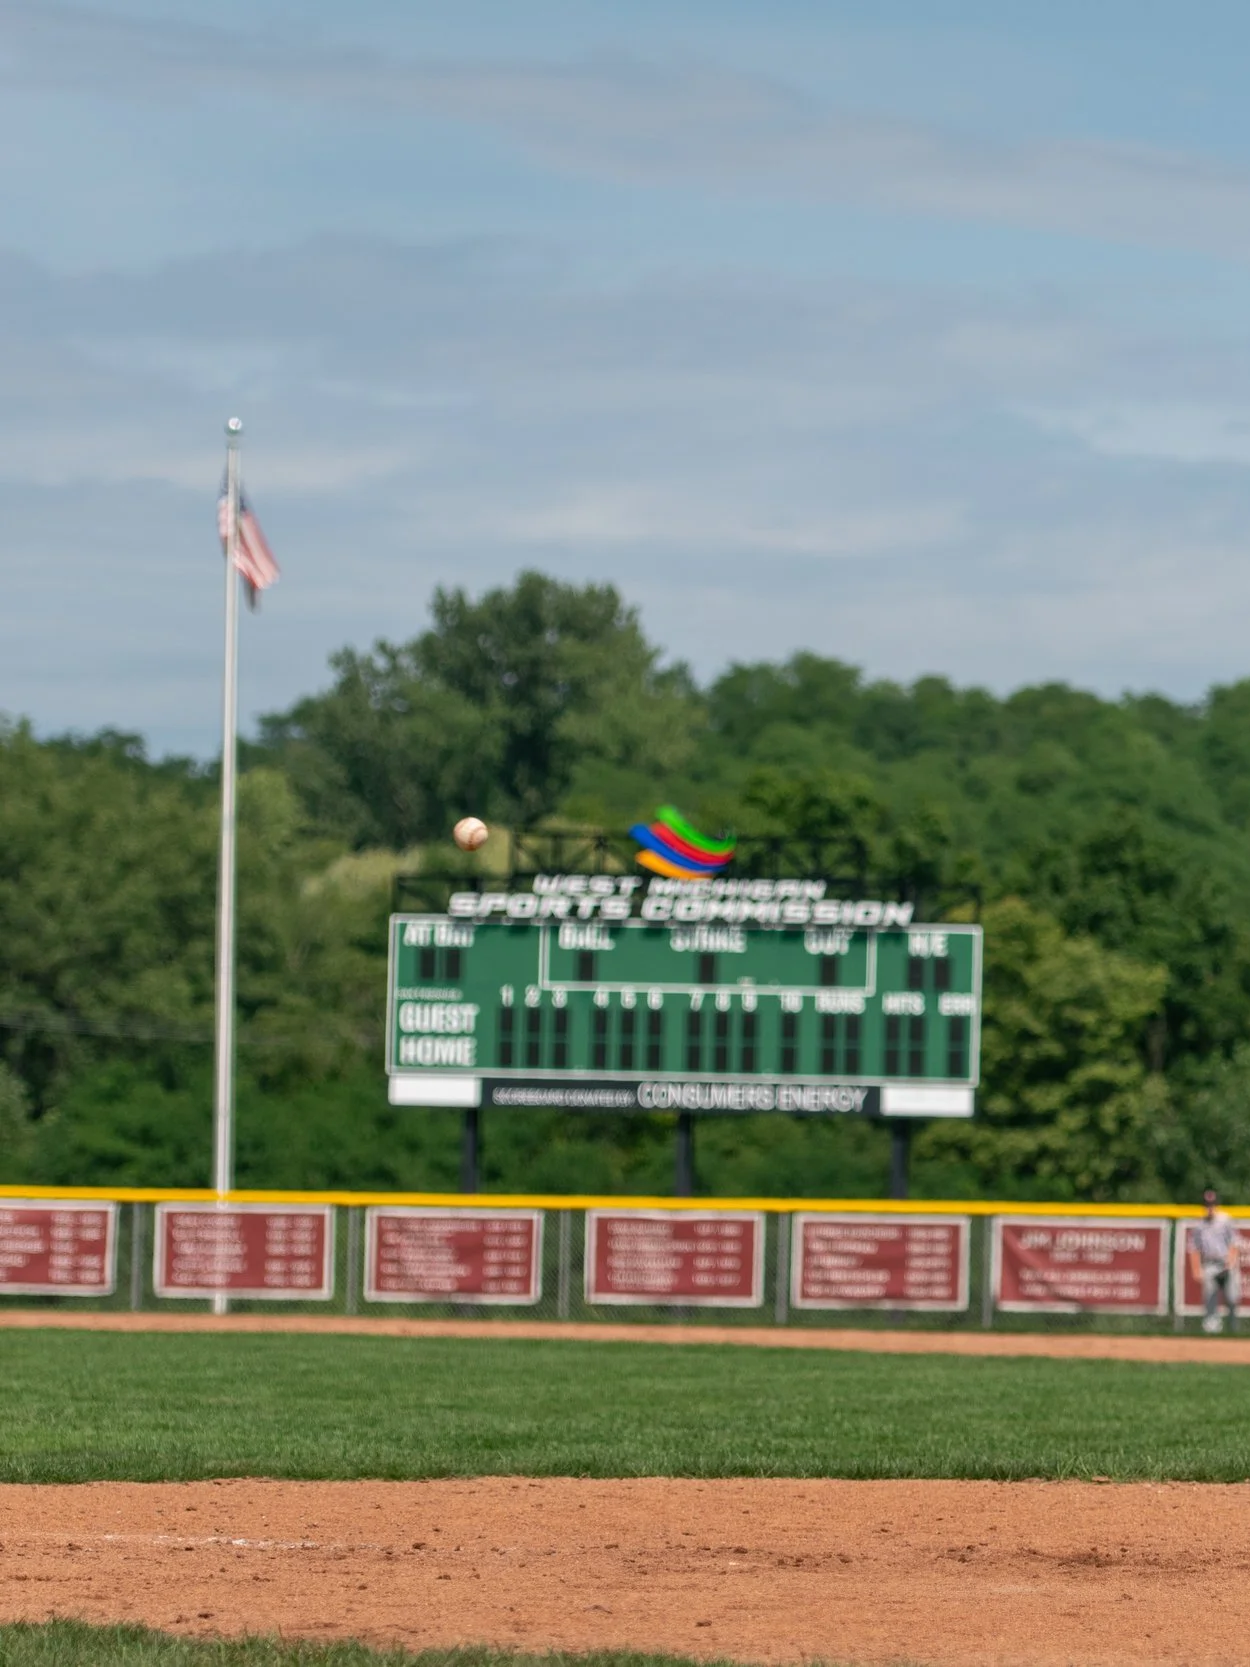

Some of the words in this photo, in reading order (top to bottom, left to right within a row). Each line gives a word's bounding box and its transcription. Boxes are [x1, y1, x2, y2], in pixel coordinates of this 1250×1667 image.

[533, 874, 643, 897] WEST
[648, 877, 827, 901] MICHIGAN
[449, 892, 632, 920] SPORTS
[641, 895, 914, 927] COMMISSION
[404, 923, 433, 946] AT
[525, 984, 541, 1008] 2
[400, 1002, 479, 1034] GUEST
[401, 1036, 477, 1067] HOME
[637, 1081, 775, 1111] CONSUMERS
[776, 1084, 868, 1113] ENERGY
